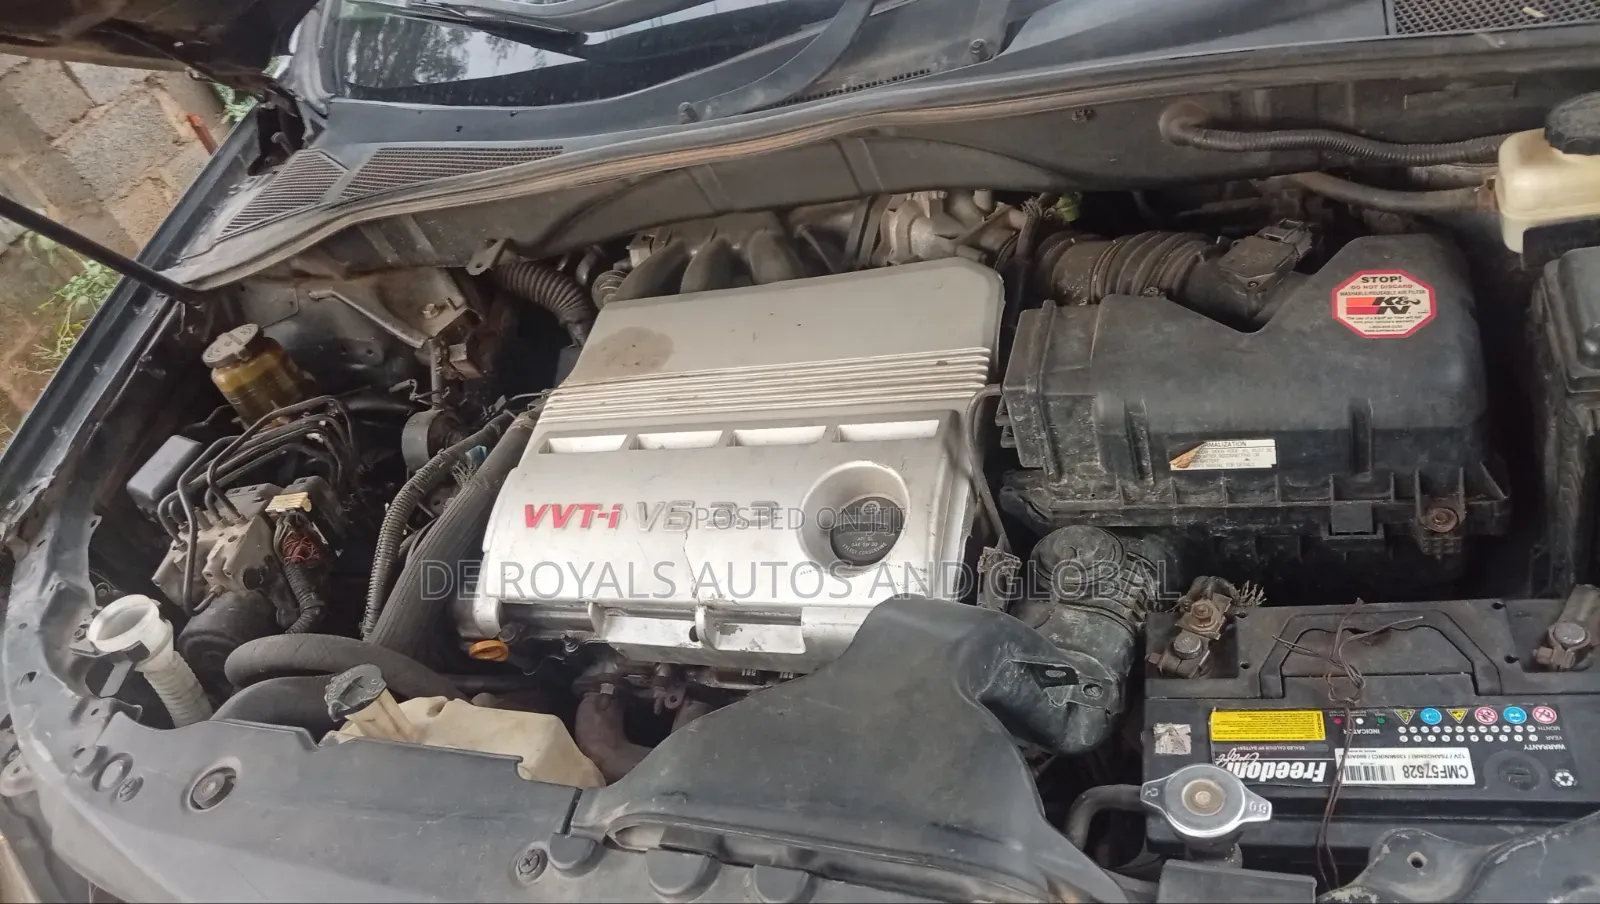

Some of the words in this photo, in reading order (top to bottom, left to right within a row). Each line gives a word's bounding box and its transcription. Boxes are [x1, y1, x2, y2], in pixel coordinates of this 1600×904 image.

[1361, 275, 1402, 283] STOP!
[523, 503, 622, 530] VVT-i
[636, 500, 696, 532] V6
[1226, 761, 1327, 783] Freedom
[1402, 764, 1468, 779] CMF57528
